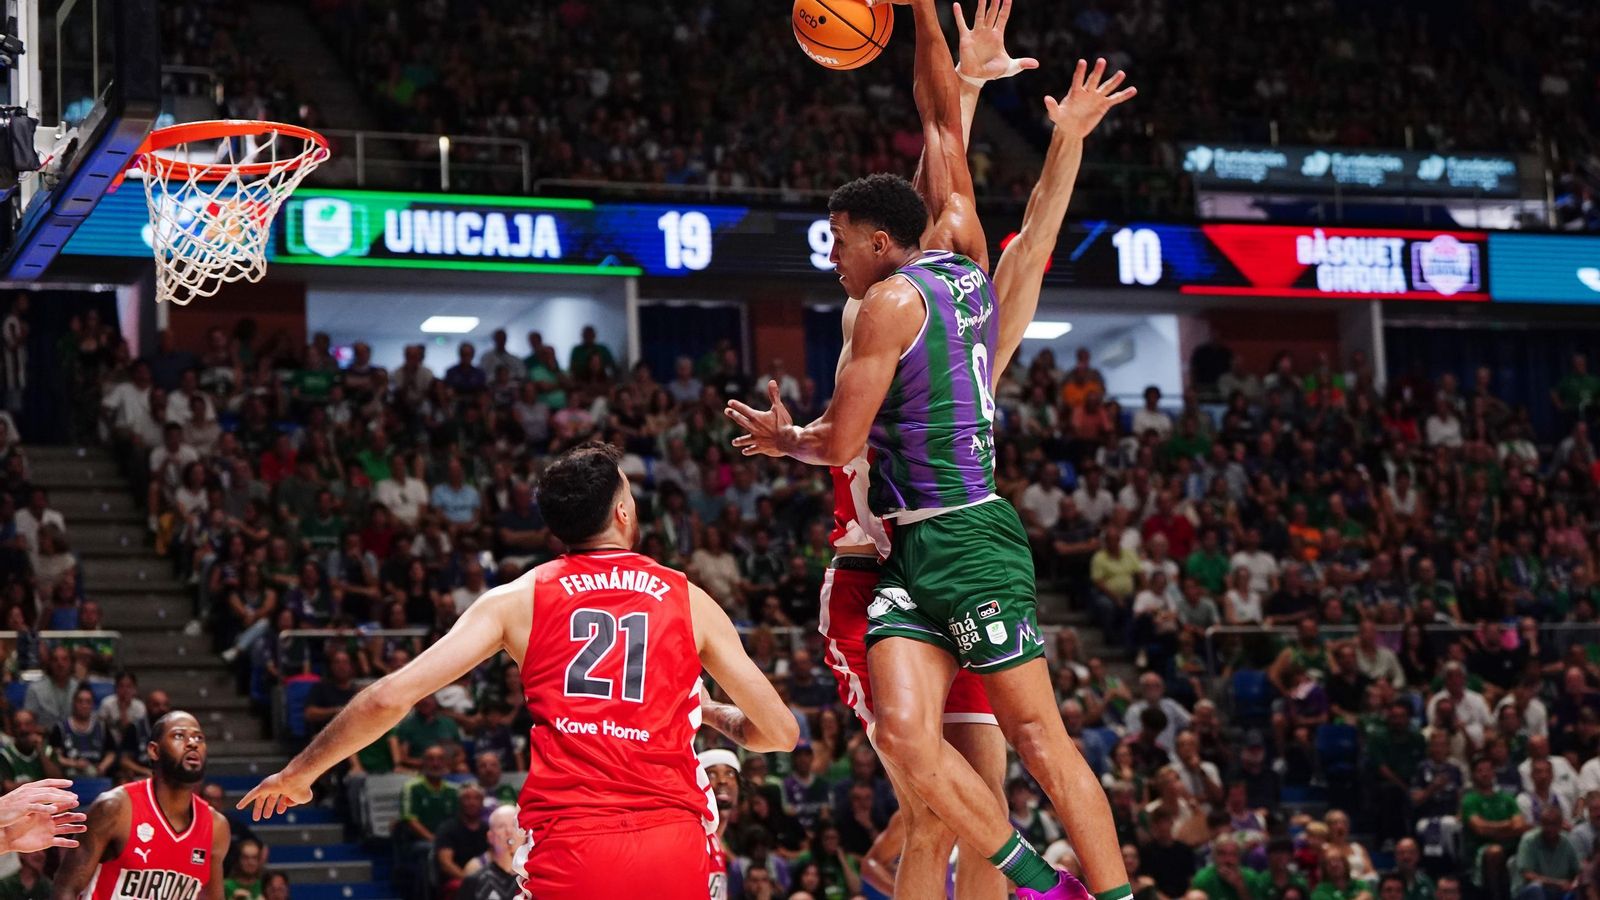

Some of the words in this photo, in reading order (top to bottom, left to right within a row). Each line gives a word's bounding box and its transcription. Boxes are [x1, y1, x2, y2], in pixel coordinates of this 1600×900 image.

[799, 8, 818, 29] acb
[384, 209, 562, 258] UNICAJA
[658, 210, 712, 271] 19
[1112, 227, 1162, 285] 10
[1317, 263, 1407, 293] GIRONA
[559, 566, 671, 602] FERNÁNDEZ
[980, 607, 996, 617] acb
[564, 607, 648, 703] 21
[555, 717, 598, 735] Kave
[602, 719, 650, 742] Home
[120, 868, 200, 900] GIRONA
